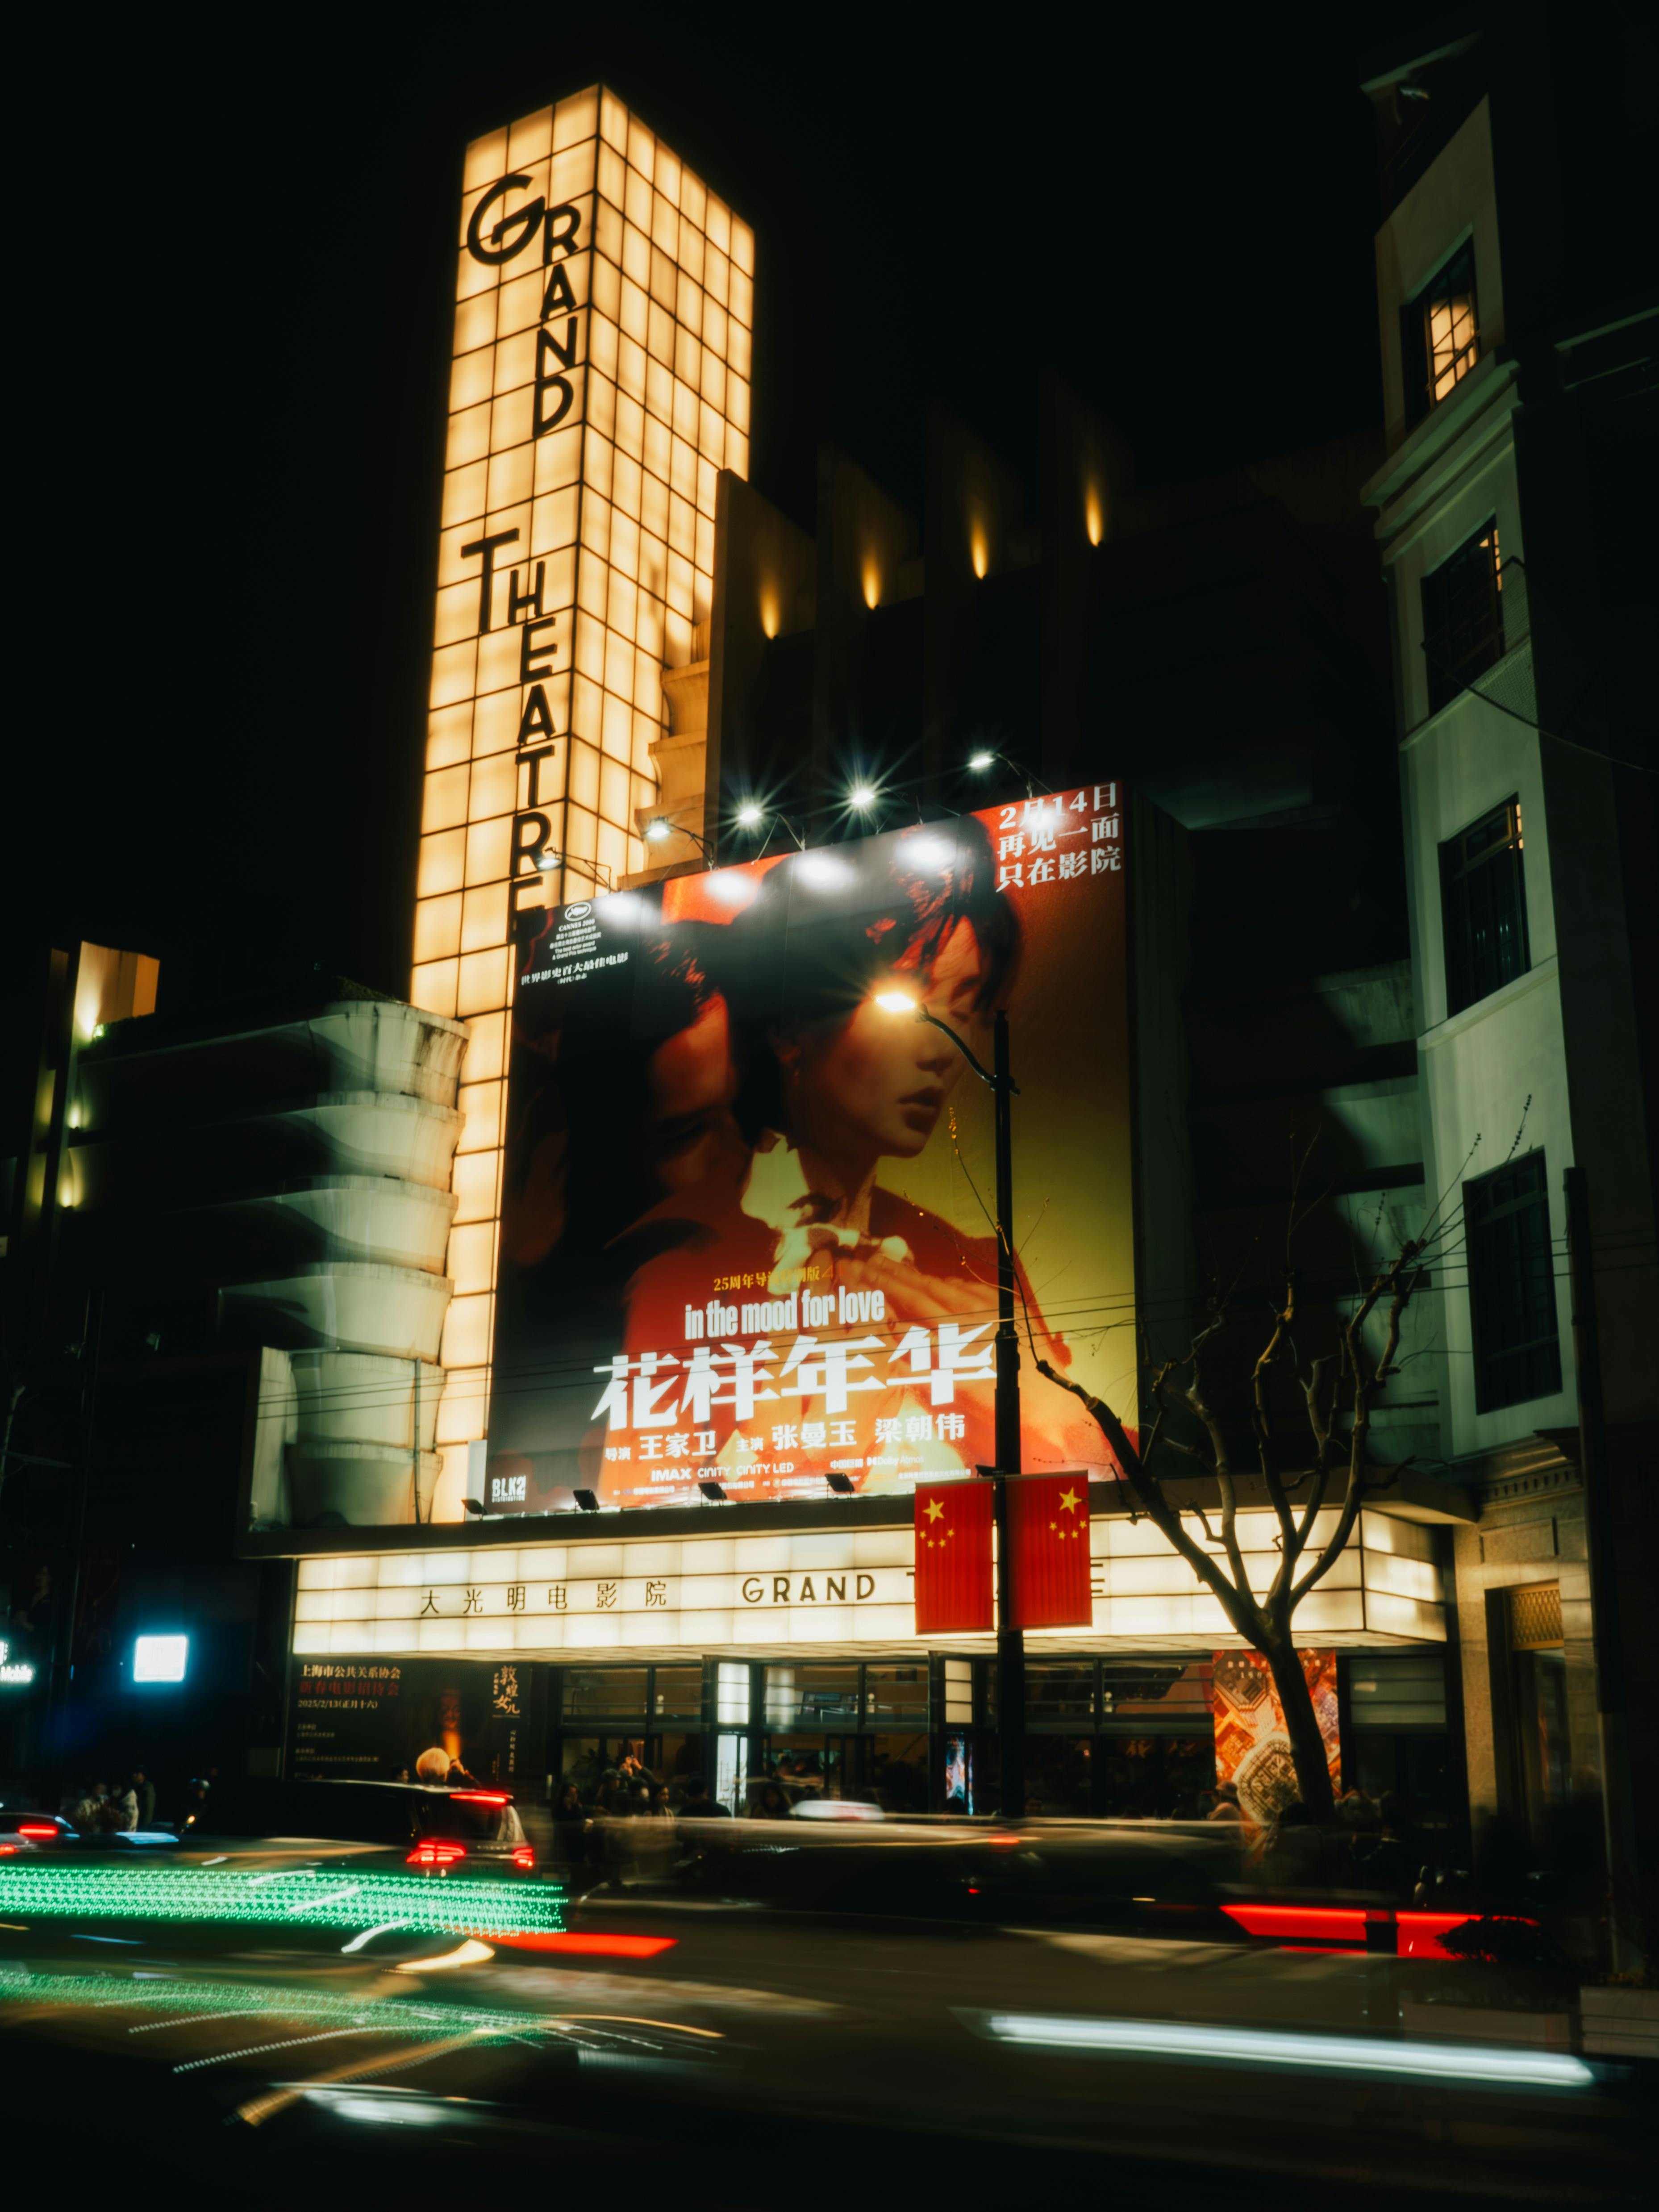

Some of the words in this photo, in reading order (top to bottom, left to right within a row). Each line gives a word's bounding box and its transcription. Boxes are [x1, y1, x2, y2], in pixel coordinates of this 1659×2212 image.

[467, 174, 581, 439] GRAND
[461, 528, 557, 942] THEATRE
[999, 782, 1116, 830] 2月14日
[997, 813, 1119, 861] 再见一面
[996, 846, 1121, 893] 只在影院
[559, 921, 581, 932] CANNES
[685, 1304, 704, 1340] in
[706, 1300, 738, 1338] the
[742, 1291, 797, 1334] mood
[801, 1289, 835, 1327] for
[839, 1285, 885, 1324] love
[591, 1322, 997, 1431] 花样年华
[605, 1447, 631, 1461] 导演
[638, 1430, 717, 1460] 王家卫
[736, 1437, 763, 1452] 主演
[771, 1420, 857, 1450] 张曼玉
[875, 1413, 965, 1444] 梁朝伟
[878, 1456, 899, 1466] Dolby
[651, 1468, 692, 1482] IMAX
[773, 1462, 794, 1473] LED
[421, 1580, 667, 1615] 大光明电影院
[742, 1574, 875, 1603] GRAND
[302, 1665, 400, 1679] 上海市公共关系协会
[493, 1665, 520, 1714] 敦煌女儿
